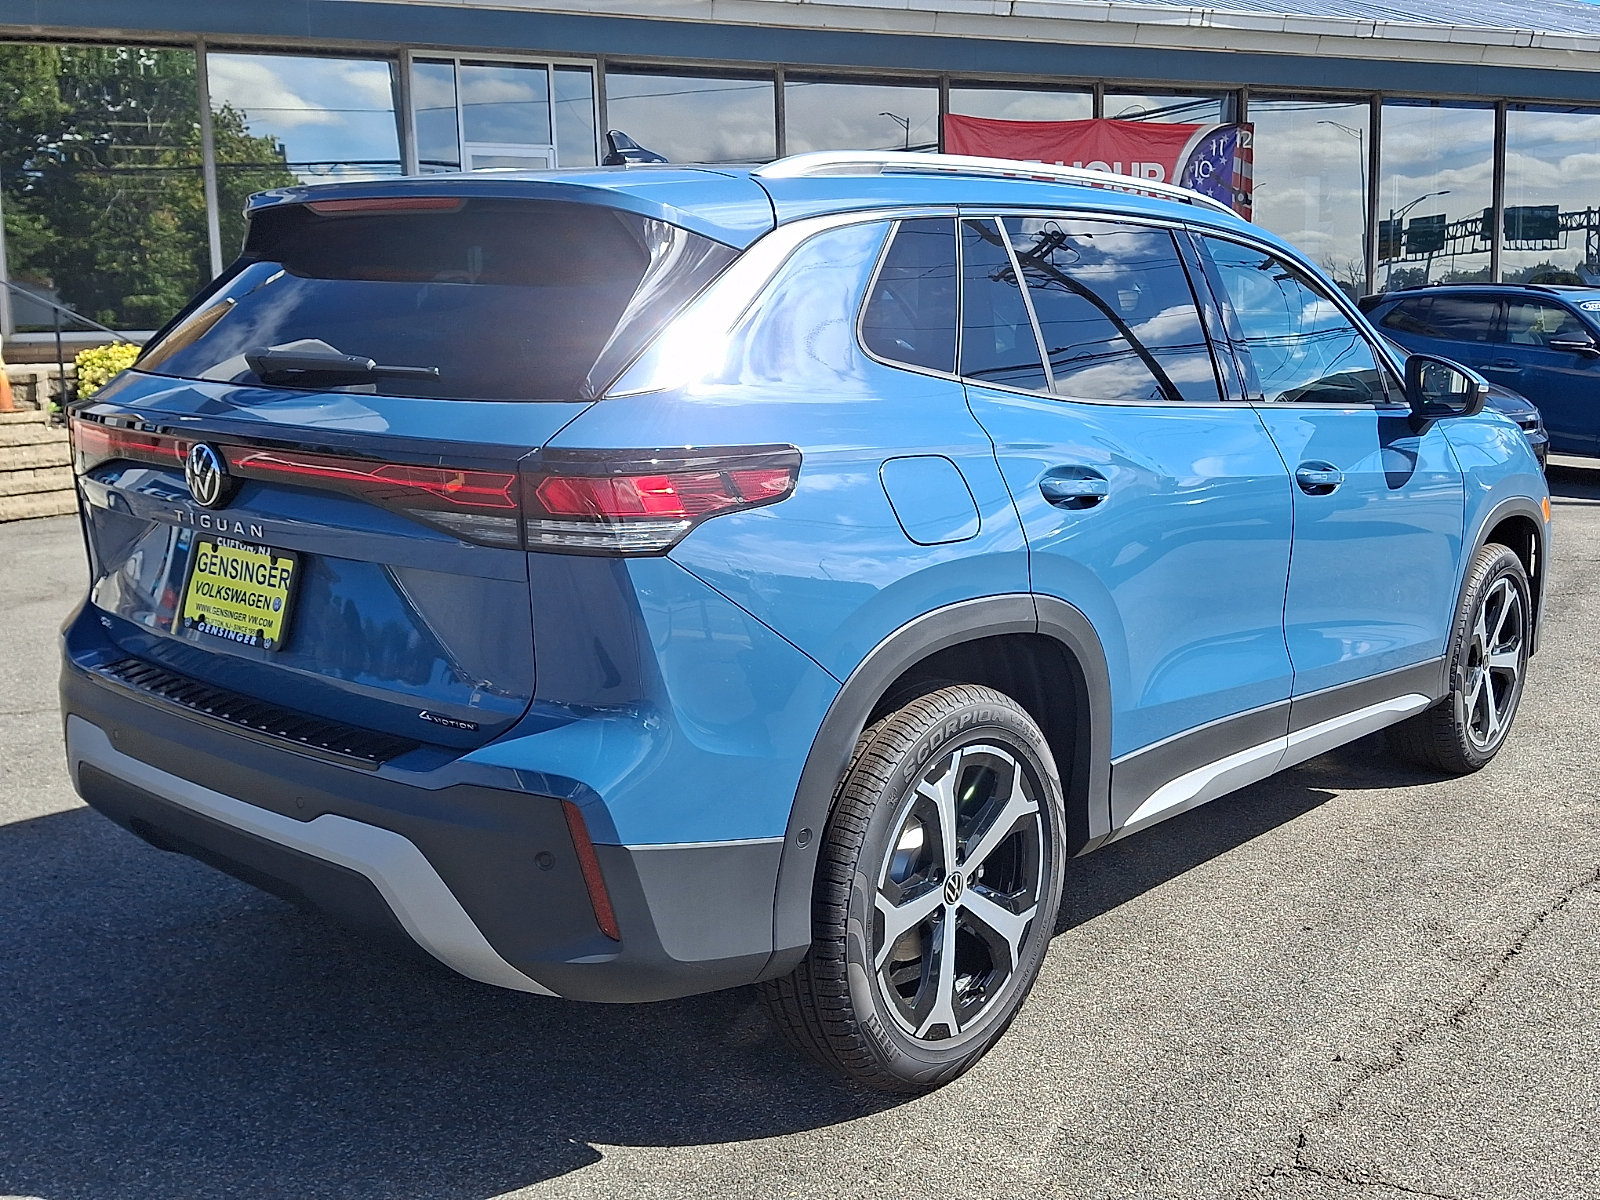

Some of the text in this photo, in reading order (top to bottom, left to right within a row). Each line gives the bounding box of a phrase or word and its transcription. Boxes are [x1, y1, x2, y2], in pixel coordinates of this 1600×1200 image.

[1211, 138, 1224, 157] 11
[1235, 127, 1252, 149] 12
[1194, 160, 1213, 178] 10
[174, 509, 265, 538] TIGUAN
[197, 552, 291, 591] GENSINGER
[195, 580, 272, 611] VOLKSWAGEN
[197, 621, 257, 646] GENSINGER
[418, 710, 475, 730] 4MOTION
[903, 708, 1005, 783] SCORPION
